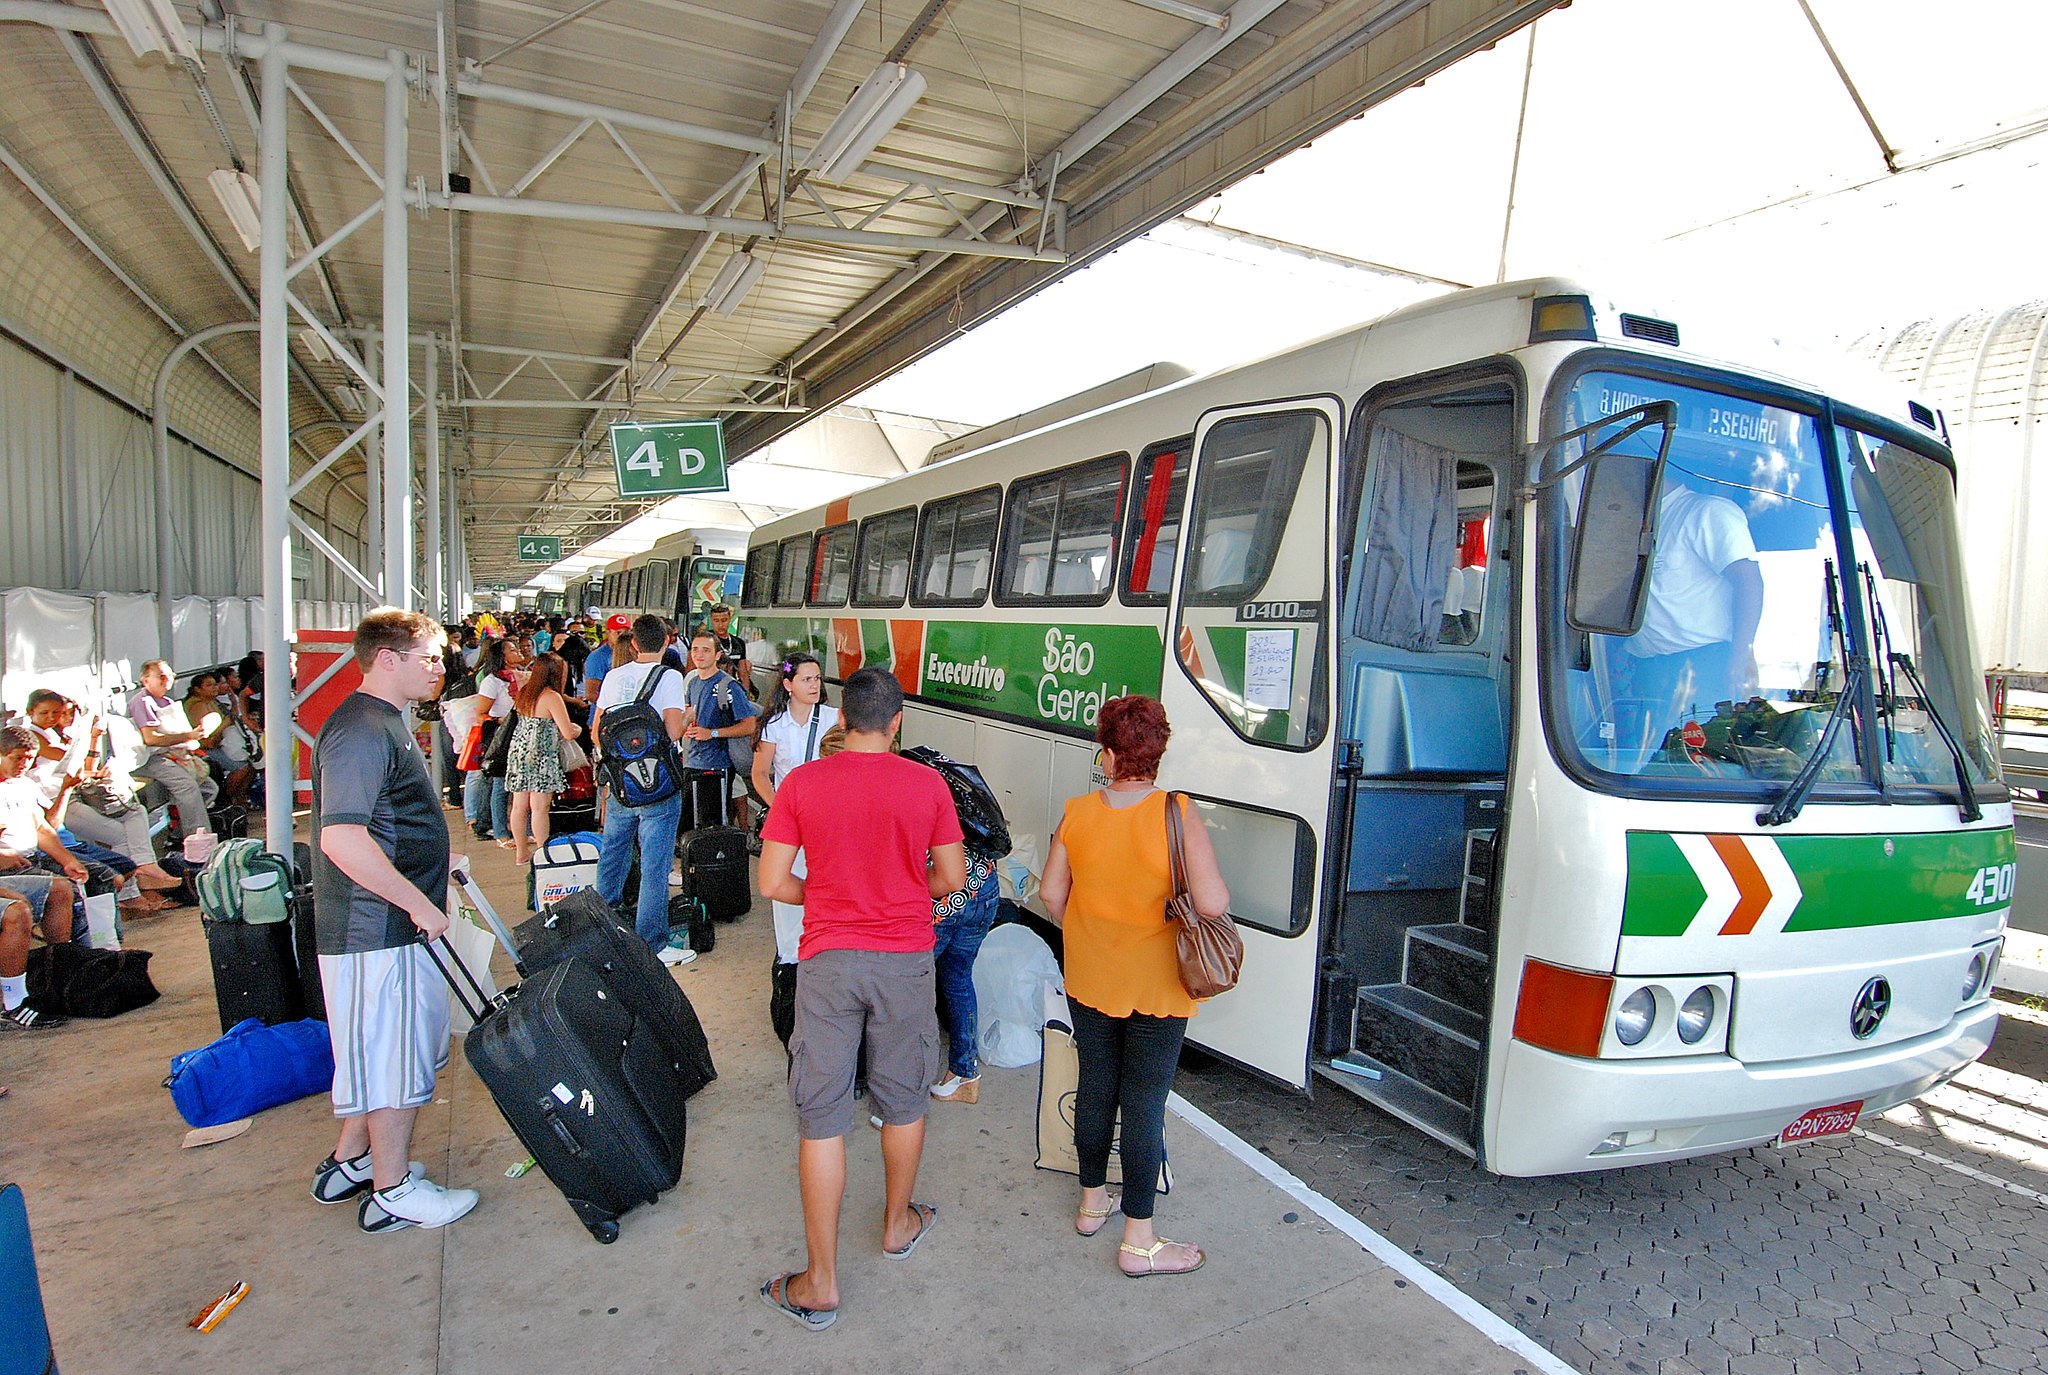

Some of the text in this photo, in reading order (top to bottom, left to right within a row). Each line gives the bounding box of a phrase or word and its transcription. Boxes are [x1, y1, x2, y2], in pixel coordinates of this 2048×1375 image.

[626, 441, 705, 477] 4 D
[522, 542, 550, 554] 4 C
[1042, 627, 1094, 676] São
[927, 653, 1005, 692] Executivo
[1037, 673, 1128, 726] Geral
